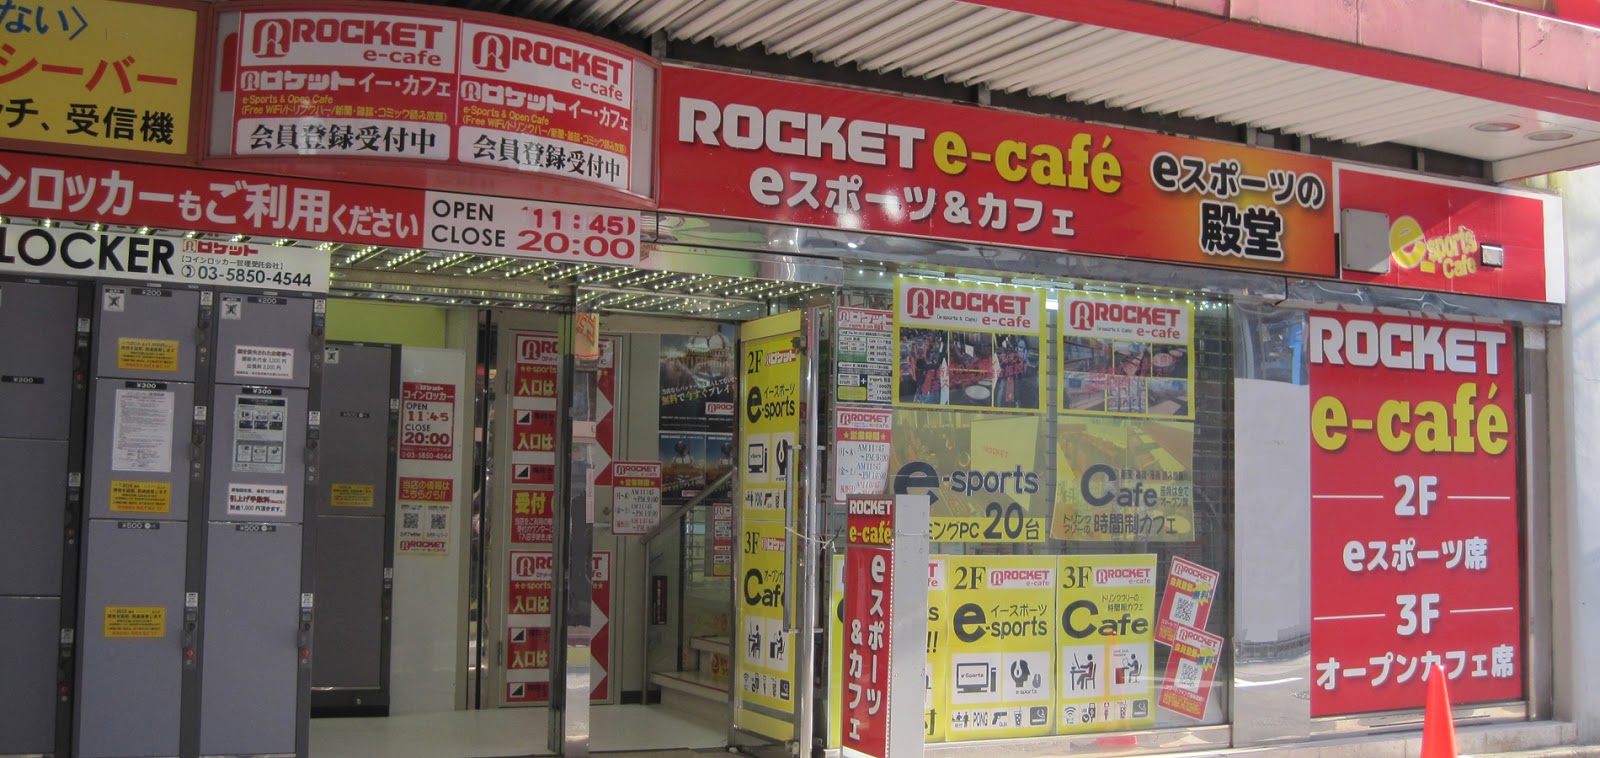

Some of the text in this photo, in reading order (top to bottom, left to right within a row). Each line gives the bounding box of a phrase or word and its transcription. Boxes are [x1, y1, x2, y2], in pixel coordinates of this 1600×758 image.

[292, 19, 443, 50] ROCKET
[363, 48, 441, 66] e-cafe
[511, 37, 623, 85] ROCKET
[288, 95, 309, 106] Open
[314, 95, 333, 104] Cafe
[572, 77, 623, 101] e-cafe
[509, 111, 529, 122] Open
[532, 114, 549, 125] Cafe
[251, 124, 435, 154] 会員登録受付中
[678, 96, 1122, 194] ROCKET e-café
[473, 134, 619, 182] 会員登録受付中
[1152, 152, 1324, 209] eスポーツの
[431, 200, 494, 222] OPEN
[749, 166, 1075, 236] eスポーツ&カフェ
[431, 224, 635, 259] CLOSE 20:00
[1200, 202, 1284, 262] 殿堂
[198, 240, 258, 256] ロケット
[198, 265, 312, 287] 03-5850-4544
[1443, 257, 1477, 278] Cafe
[935, 289, 1031, 316] ROCKET
[850, 312, 893, 325] ロケット
[982, 314, 1031, 328] e-cafe
[1095, 303, 1180, 327] ROCKET
[1137, 326, 1180, 339] e-cafe
[1310, 316, 1506, 374] ROCKET
[748, 350, 763, 374] 2F
[404, 390, 454, 400] コインロッカー
[764, 384, 795, 398] イースポーツ
[406, 403, 428, 411] OPEN
[408, 411, 449, 422] 11:45
[851, 414, 889, 423] ROCKET
[1311, 382, 1508, 455] e-café
[404, 432, 449, 445] 20:00
[405, 424, 430, 432] CLOSE
[1081, 464, 1158, 507] Cafe
[1394, 475, 1437, 516] 2F
[515, 492, 546, 515] 受付
[850, 500, 892, 515] ROCKET
[850, 521, 892, 544] e-café
[1094, 514, 1177, 535] 時間制カフェ
[409, 541, 446, 549] ROCKET
[744, 532, 760, 555] 3F
[1343, 536, 1488, 572] eスポーツ席
[953, 566, 986, 590] 2F
[1003, 569, 1050, 580] ROCKET
[1063, 566, 1093, 590] 3F
[1107, 568, 1151, 579] ROCKET
[1183, 566, 1213, 582] ROCKET
[744, 568, 785, 608] Caf
[953, 603, 1047, 642] e-sports
[991, 604, 1047, 618] イースポーツ
[1062, 600, 1148, 639] Cafe
[1396, 593, 1439, 636] 3F
[866, 554, 886, 716] eスポーツ
[1187, 633, 1218, 647] ROCKET
[848, 619, 863, 741] &カフェ
[973, 711, 988, 727] PONG
